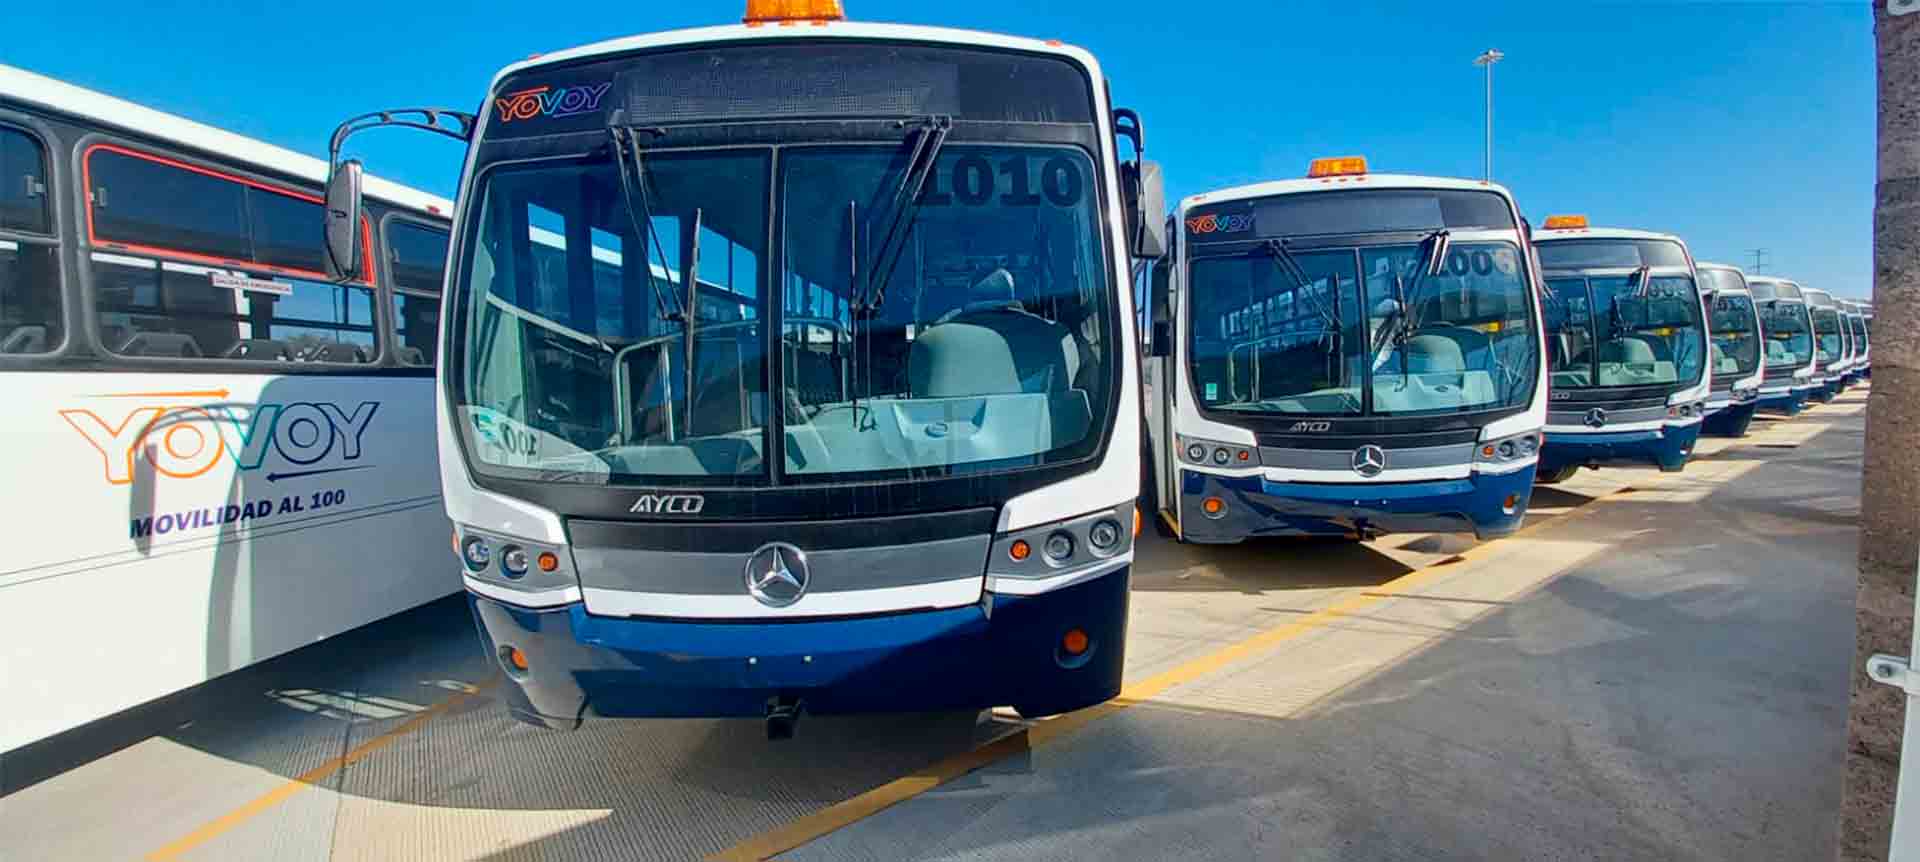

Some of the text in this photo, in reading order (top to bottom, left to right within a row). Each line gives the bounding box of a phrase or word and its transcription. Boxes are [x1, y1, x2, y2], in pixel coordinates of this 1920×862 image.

[496, 82, 612, 122] YOVOY
[912, 153, 1083, 206] 1010
[1185, 213, 1256, 234] YOVOY
[58, 402, 380, 485] YOVOY
[130, 489, 346, 539] MOVILIDAD AL 100
[629, 494, 704, 513] AYCO
